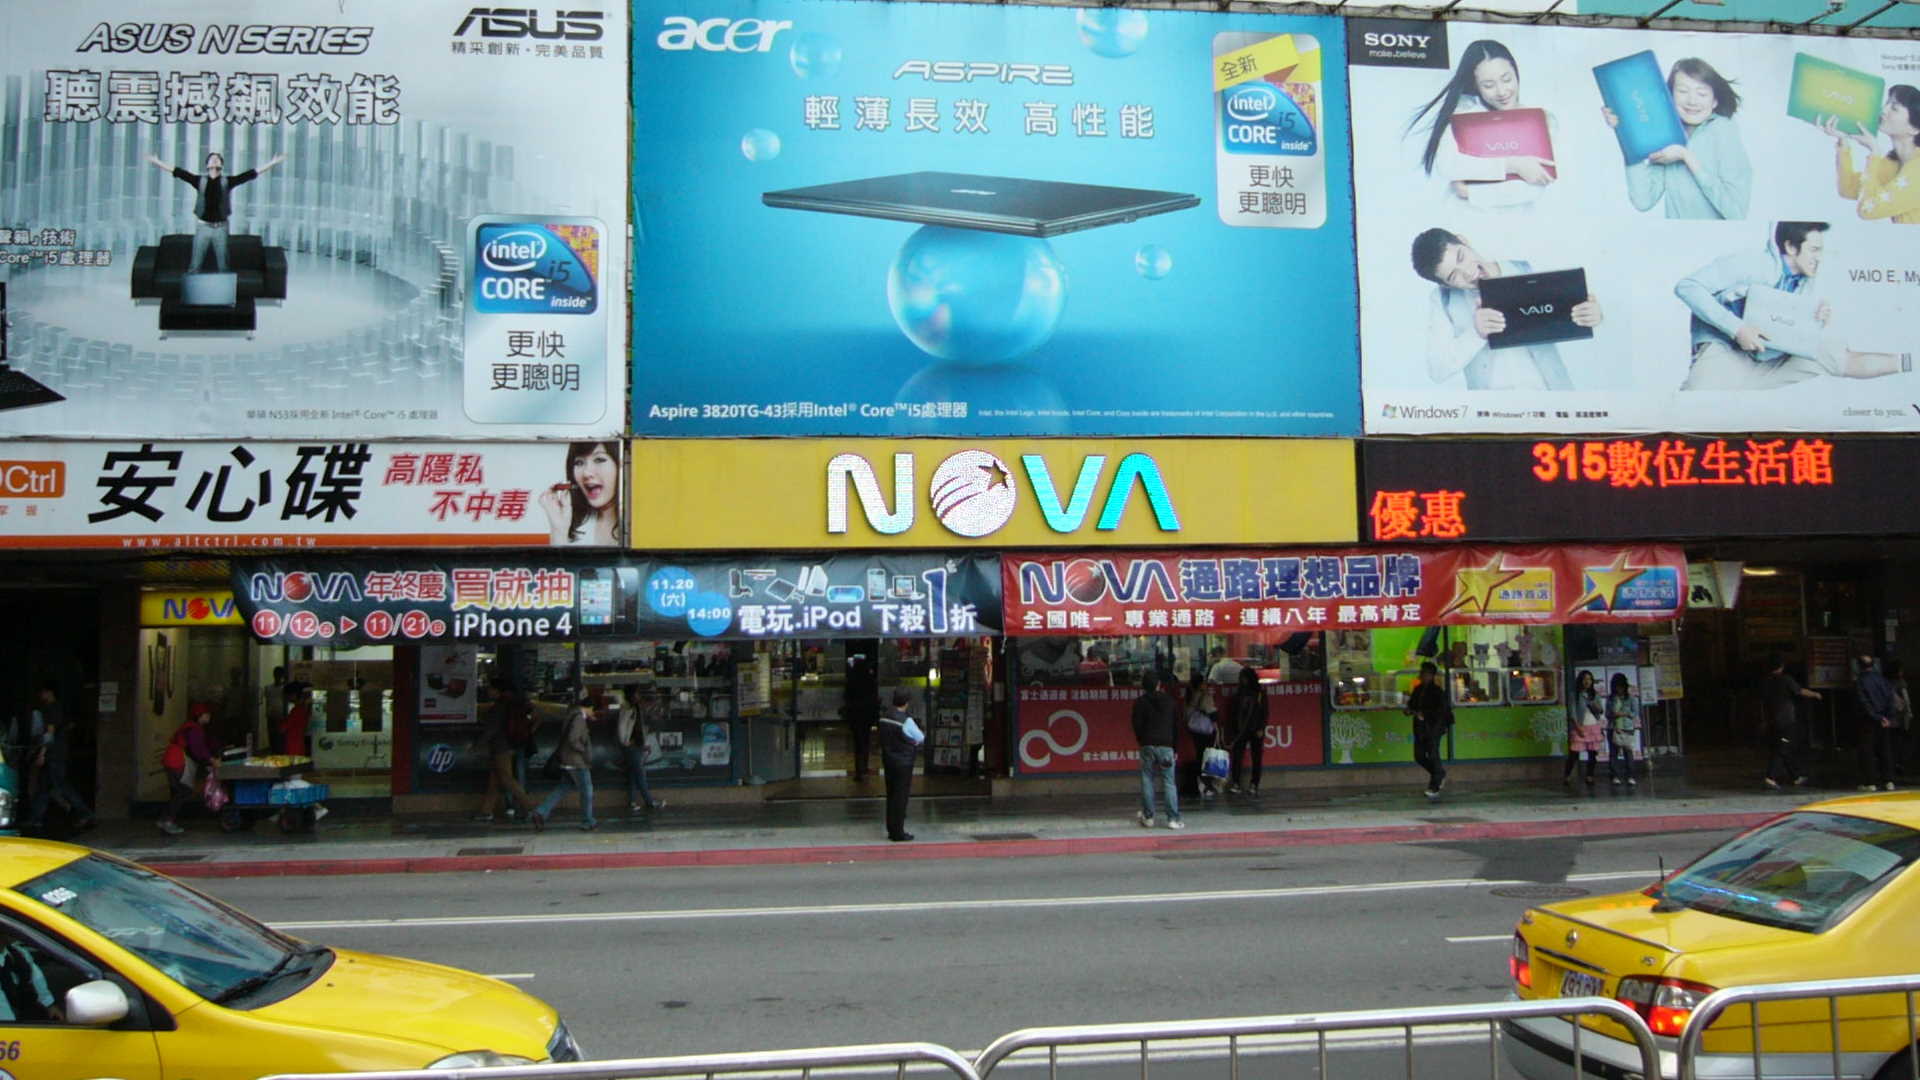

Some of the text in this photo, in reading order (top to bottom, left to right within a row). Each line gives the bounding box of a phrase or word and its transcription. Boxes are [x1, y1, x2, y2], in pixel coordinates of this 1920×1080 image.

[77, 22, 375, 55] ASUS N SERIES
[454, 8, 603, 41] ASUS
[657, 16, 793, 52] acer
[1364, 32, 1431, 48] SONY
[893, 60, 1074, 85] ASPIRE
[1220, 53, 1258, 81] 全新
[803, 95, 1155, 138] 輕薄長效 高性能
[1234, 97, 1267, 111] intel
[1277, 111, 1296, 129] i5
[1249, 164, 1294, 188] 更快
[1238, 191, 1306, 216] 更聰明
[491, 240, 536, 260] intel
[549, 260, 572, 282] i5
[1848, 269, 1882, 282] VAIO
[1519, 303, 1554, 316] VAIO
[506, 330, 565, 359] 更快
[490, 362, 580, 392] 更聰明
[649, 403, 698, 419] Aspire
[1399, 404, 1460, 419] Windows
[1461, 404, 1469, 418] 7
[382, 453, 484, 485] 高隱私
[1532, 440, 1834, 487] 315數位生活館
[0, 465, 56, 493] Ctrl
[87, 443, 372, 524] 安心碟
[429, 489, 531, 522] 不中毒
[827, 449, 1181, 538] NOVA
[1369, 489, 1467, 540] 優惠
[251, 567, 575, 611] NOVA 年終慶 買就抽
[651, 579, 694, 591] 11.20
[1019, 553, 1421, 605] NOVA 通路理想品牌
[661, 593, 686, 608] (六)
[687, 607, 731, 620] 14:00
[454, 612, 549, 637] iPhone
[555, 612, 572, 636] 4
[738, 604, 861, 635] 電玩.iPod
[1023, 609, 1113, 630] 全國唯一
[1337, 603, 1421, 623] 最高肯定
[431, 745, 453, 773] hp
